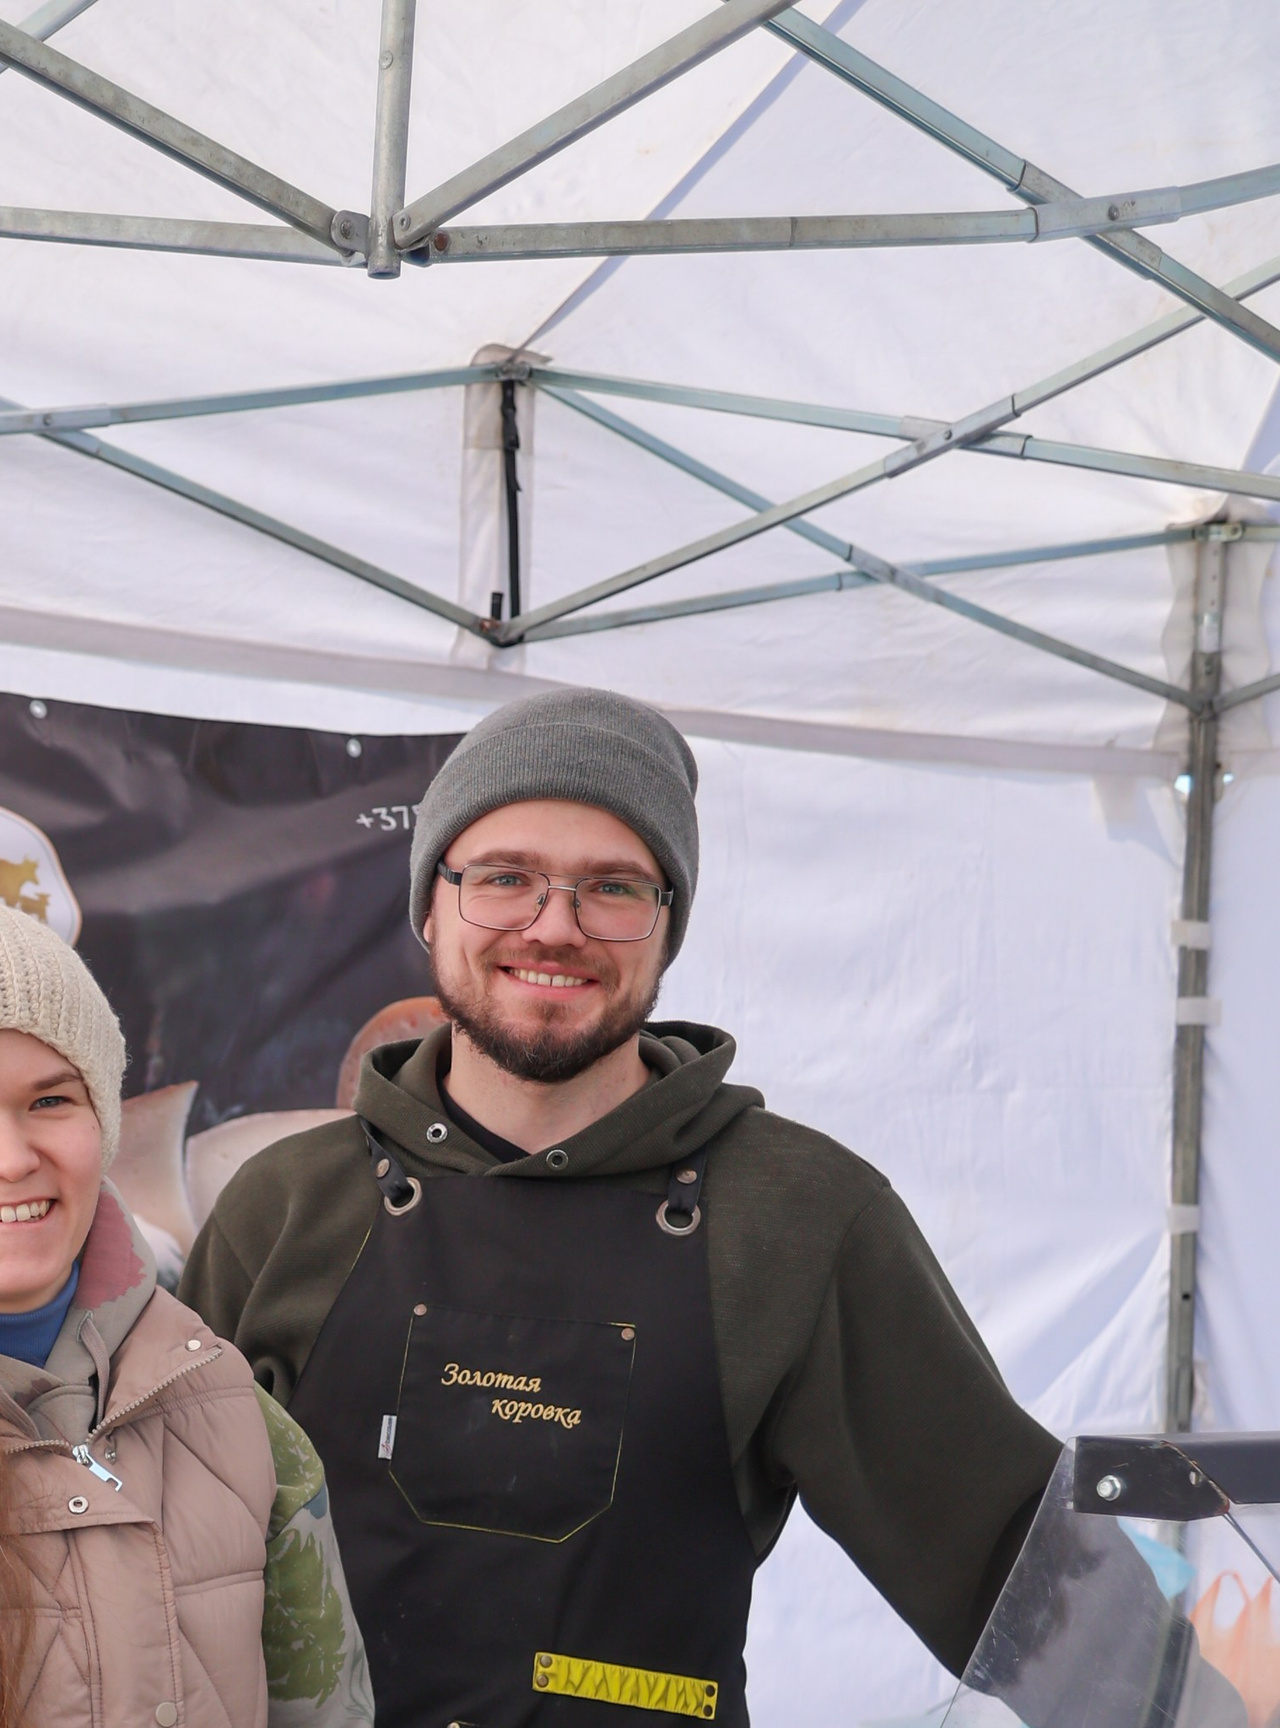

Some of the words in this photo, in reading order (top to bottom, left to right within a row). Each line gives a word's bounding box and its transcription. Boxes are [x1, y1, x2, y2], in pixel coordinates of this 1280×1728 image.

[356, 804, 419, 831] +37
[440, 1363, 542, 1393] Золотая
[491, 1398, 582, 1429] коровка
